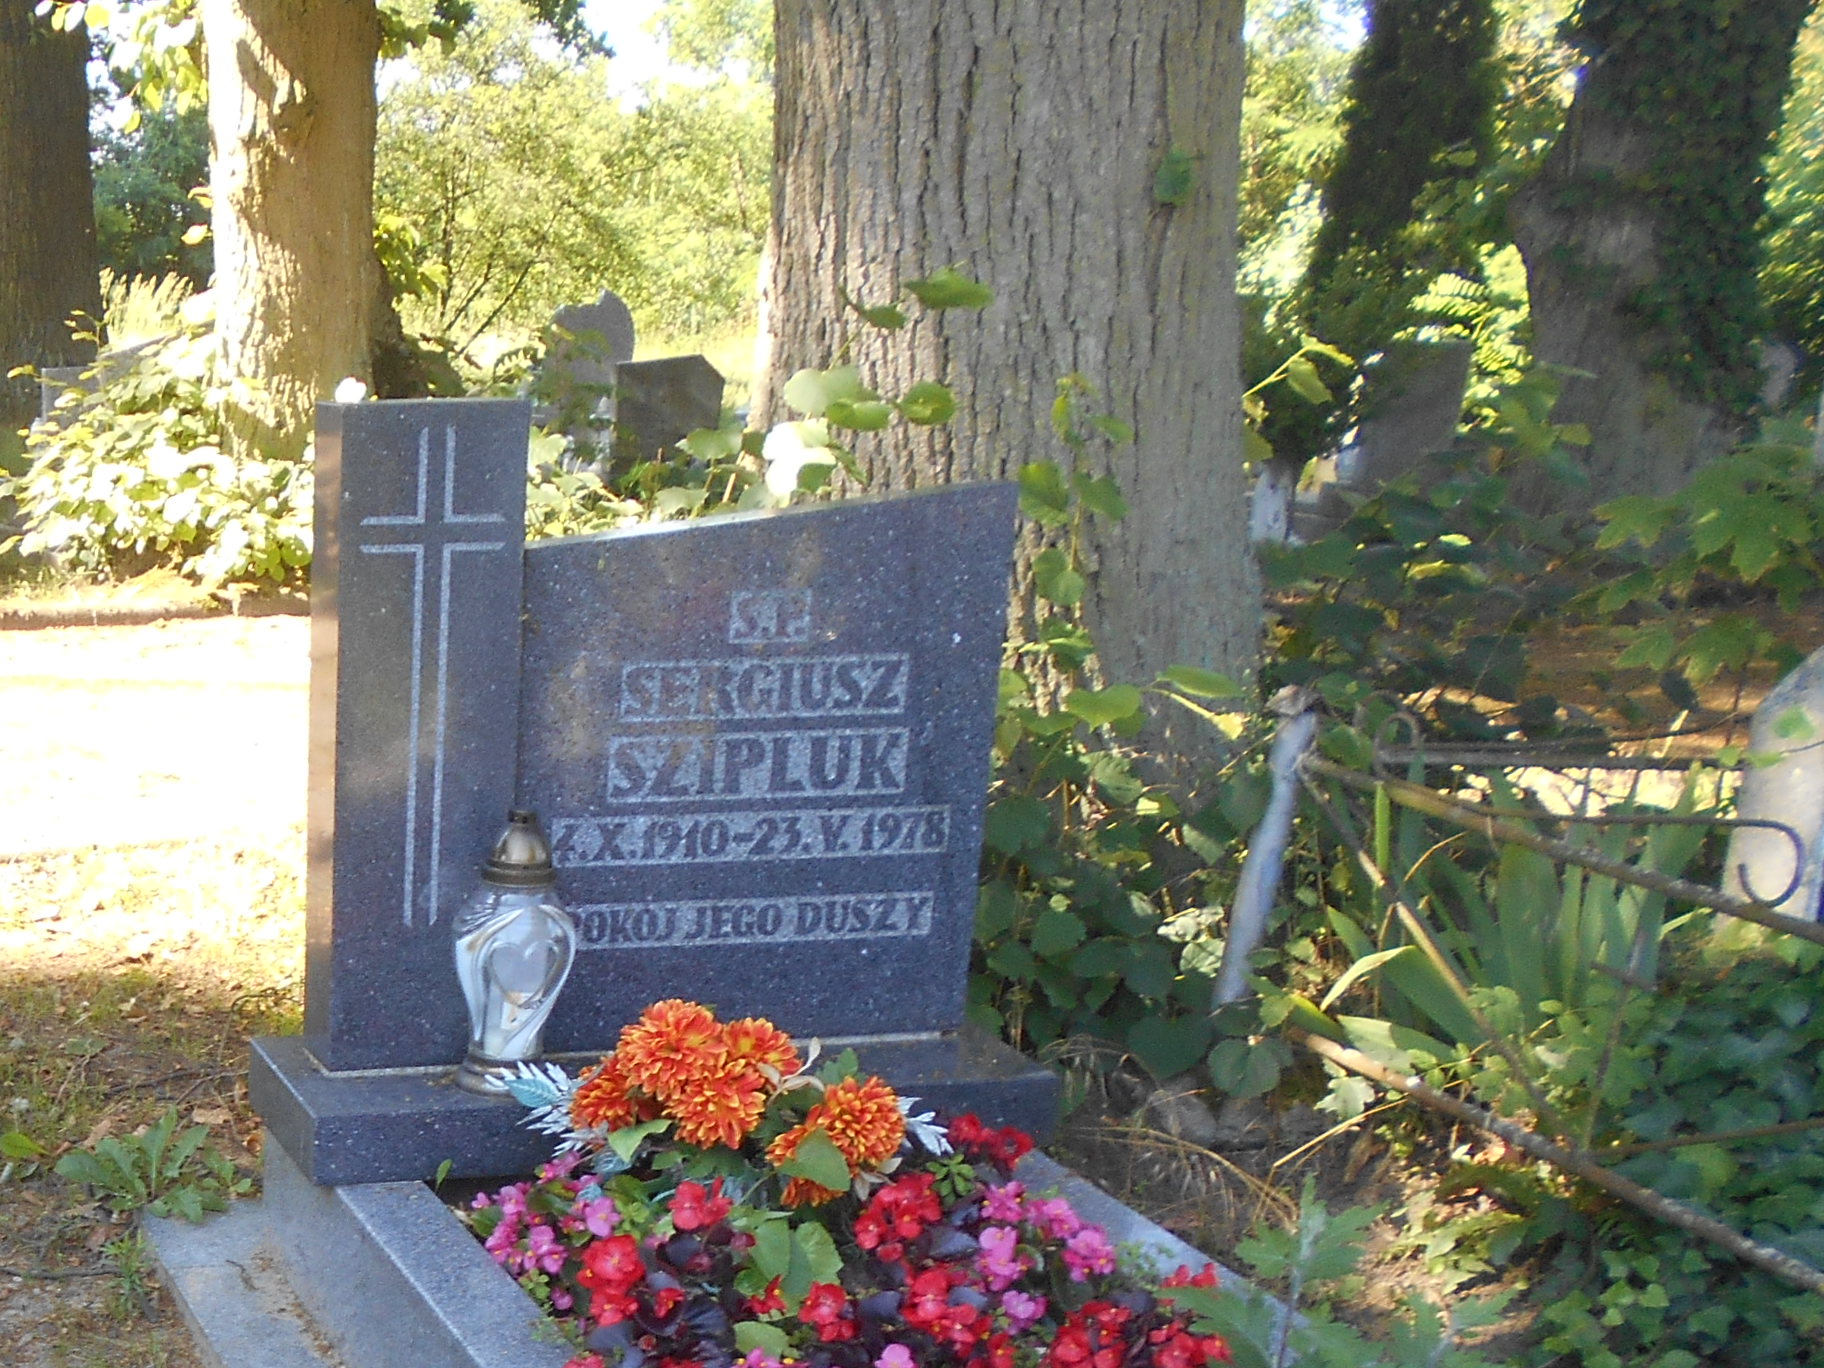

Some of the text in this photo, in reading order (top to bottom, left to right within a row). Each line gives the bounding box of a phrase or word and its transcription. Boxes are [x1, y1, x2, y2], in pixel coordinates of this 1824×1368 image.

[621, 657, 906, 717] SERGIUSZ
[610, 734, 904, 797] SZIPLUK
[683, 903, 783, 940] JEGO
[793, 896, 926, 936] DUSZY
